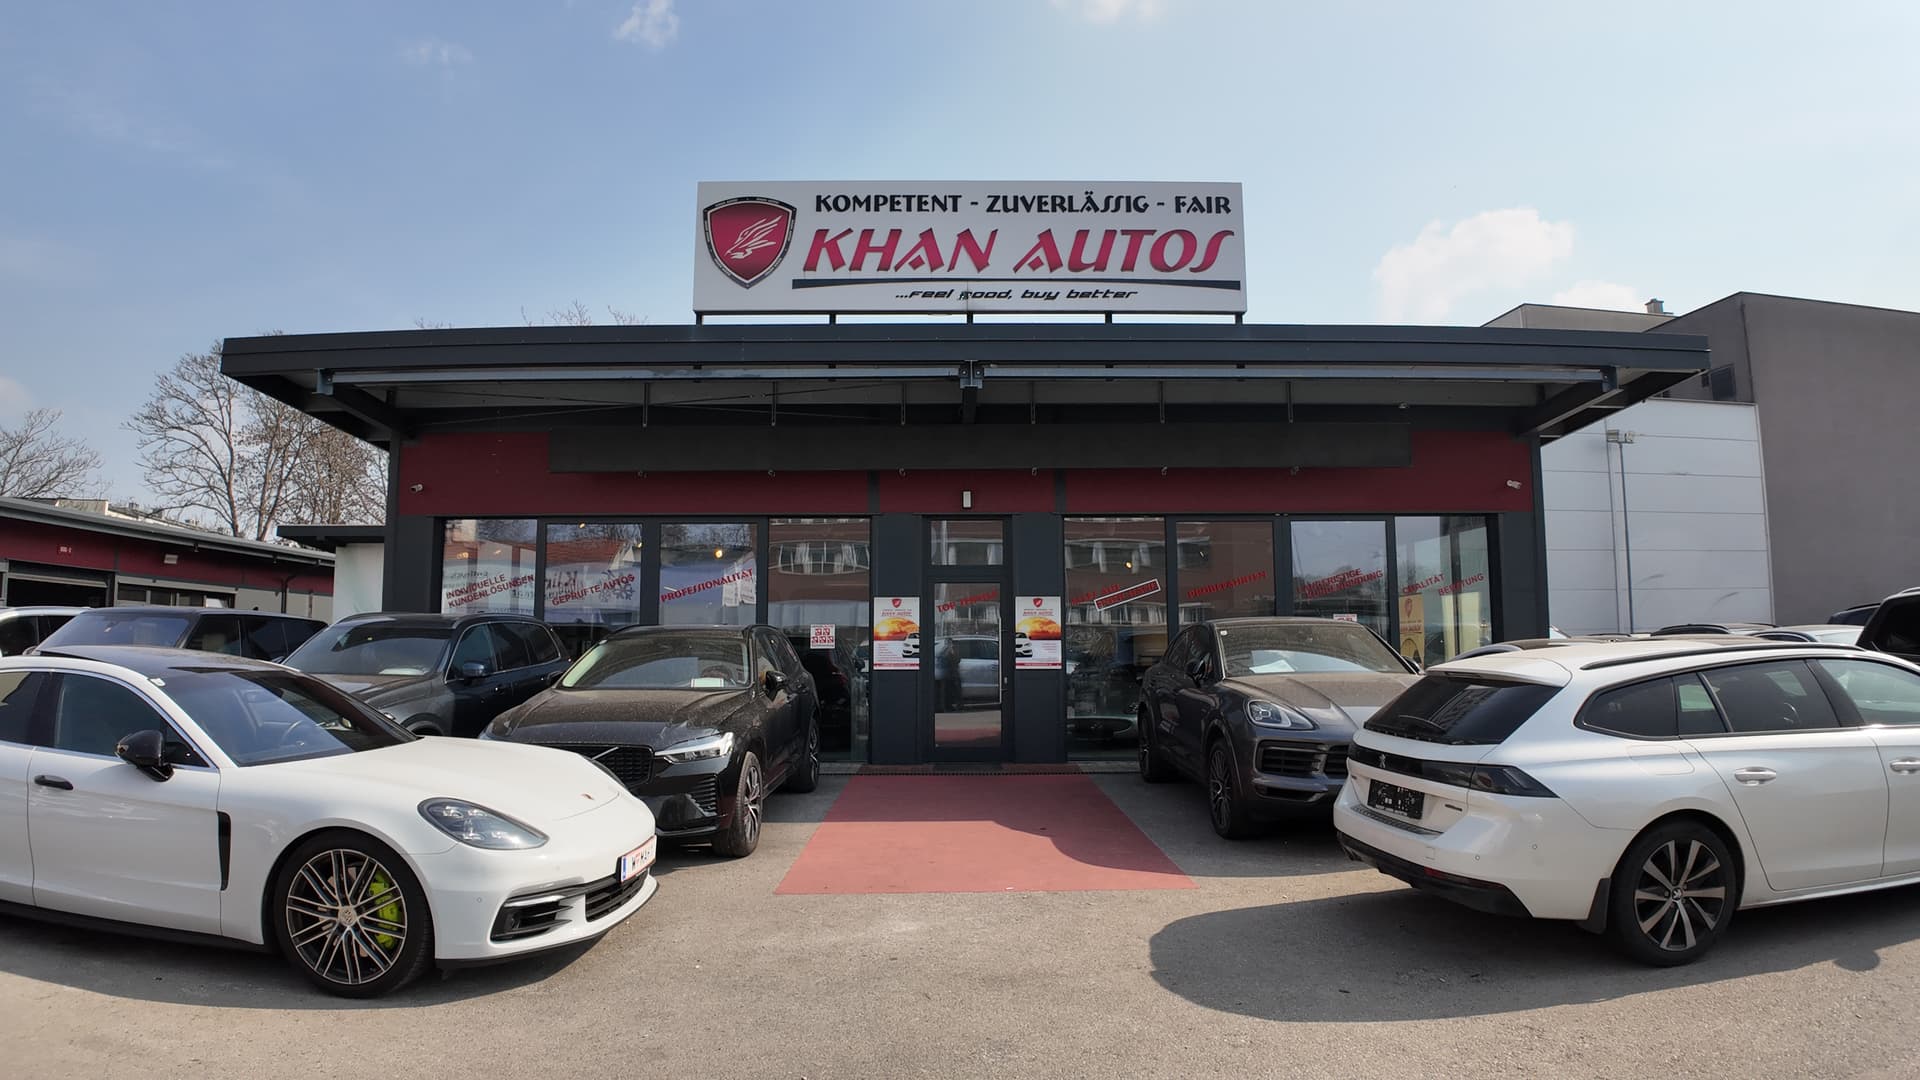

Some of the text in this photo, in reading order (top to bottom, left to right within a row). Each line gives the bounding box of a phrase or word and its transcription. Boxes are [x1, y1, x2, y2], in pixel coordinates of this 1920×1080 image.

[815, 194, 963, 213] KOMPETENT
[985, 190, 1150, 214] ZUVERLÄSSIG
[1174, 195, 1232, 215] FAIR
[802, 227, 1236, 273] KHAN AUTOS
[1020, 288, 1061, 301] buy
[1065, 288, 1139, 299] better
[446, 573, 506, 599] INDIVIDUELLE
[602, 573, 635, 591] AUTOS
[936, 600, 956, 613] TOP
